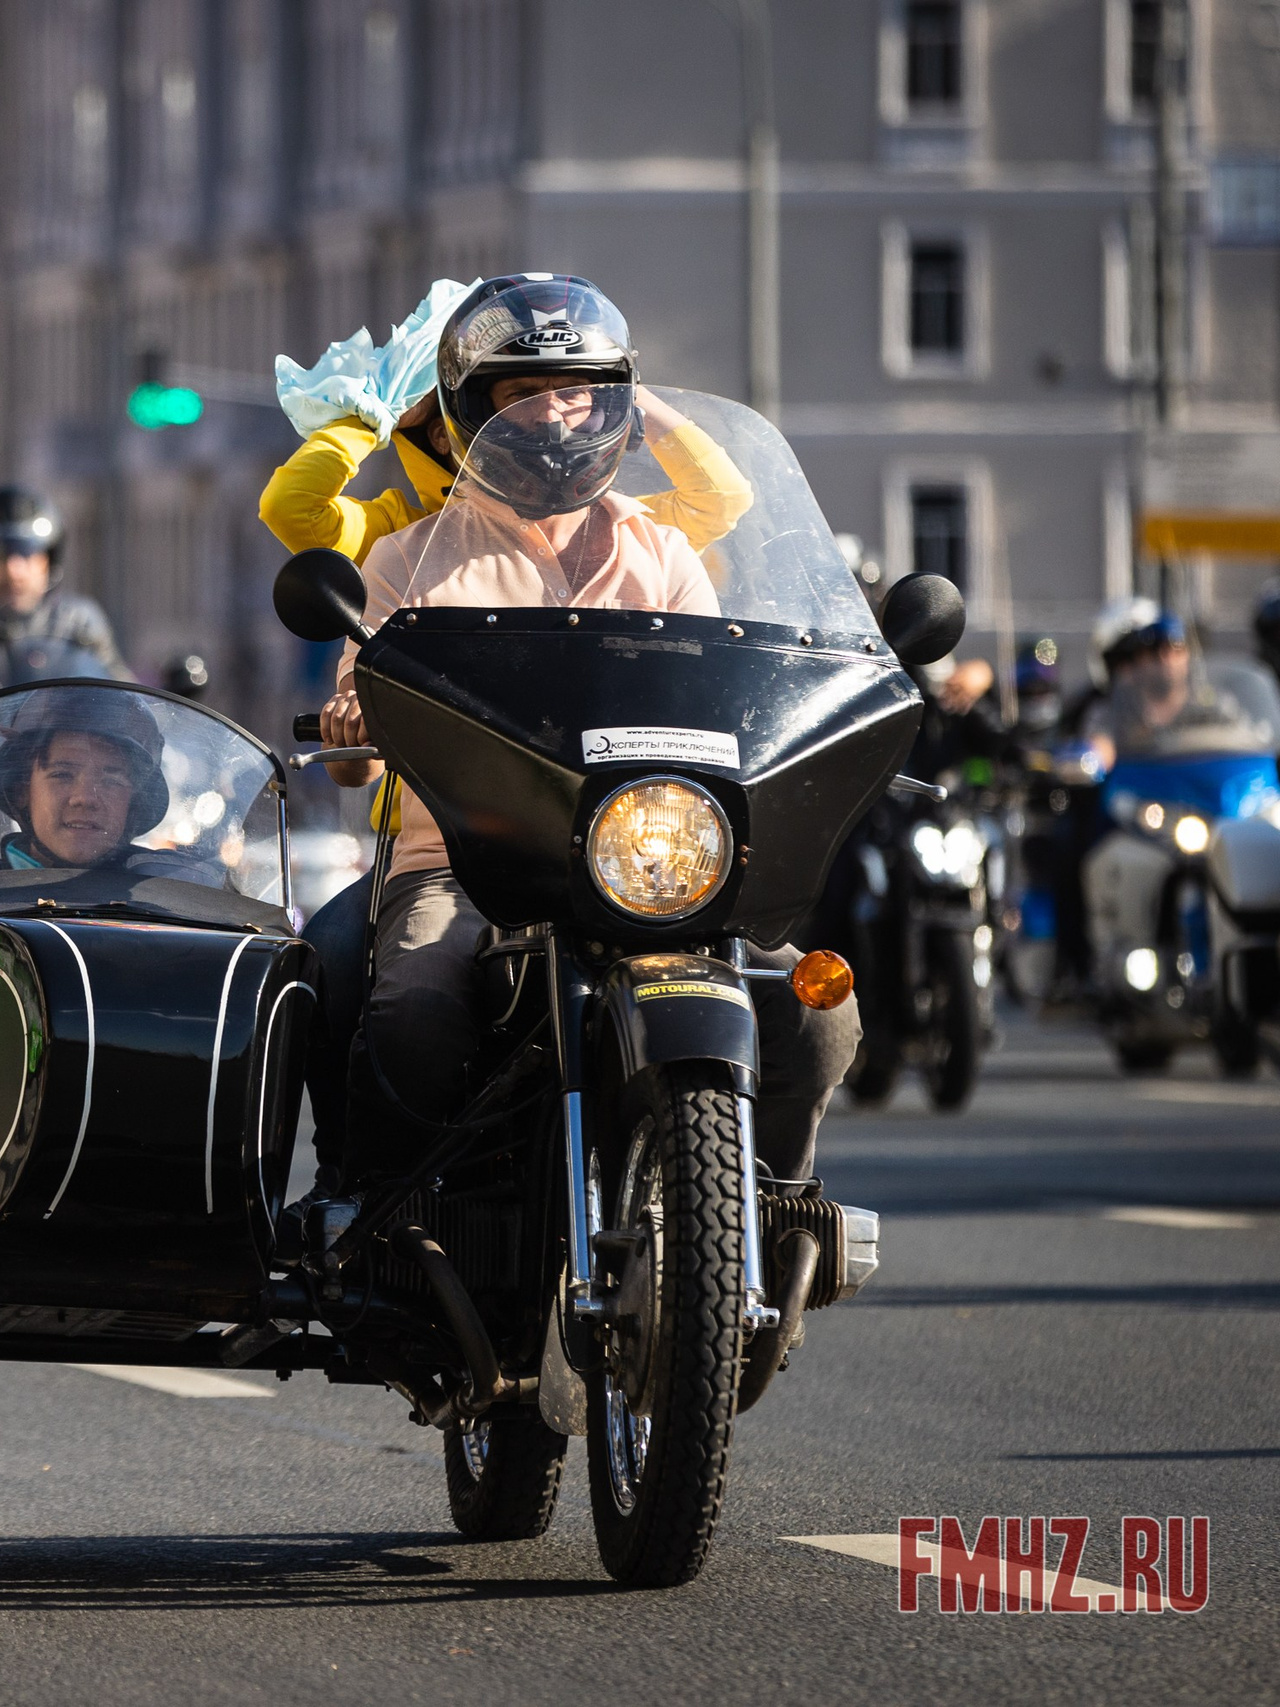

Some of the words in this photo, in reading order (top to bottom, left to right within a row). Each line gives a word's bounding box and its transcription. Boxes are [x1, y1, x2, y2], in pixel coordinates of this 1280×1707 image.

[528, 332, 573, 343] HJC
[663, 741, 735, 756] ПРИКЛЮЧЕНИЙ
[637, 985, 745, 1001] MOTOURAL.CO
